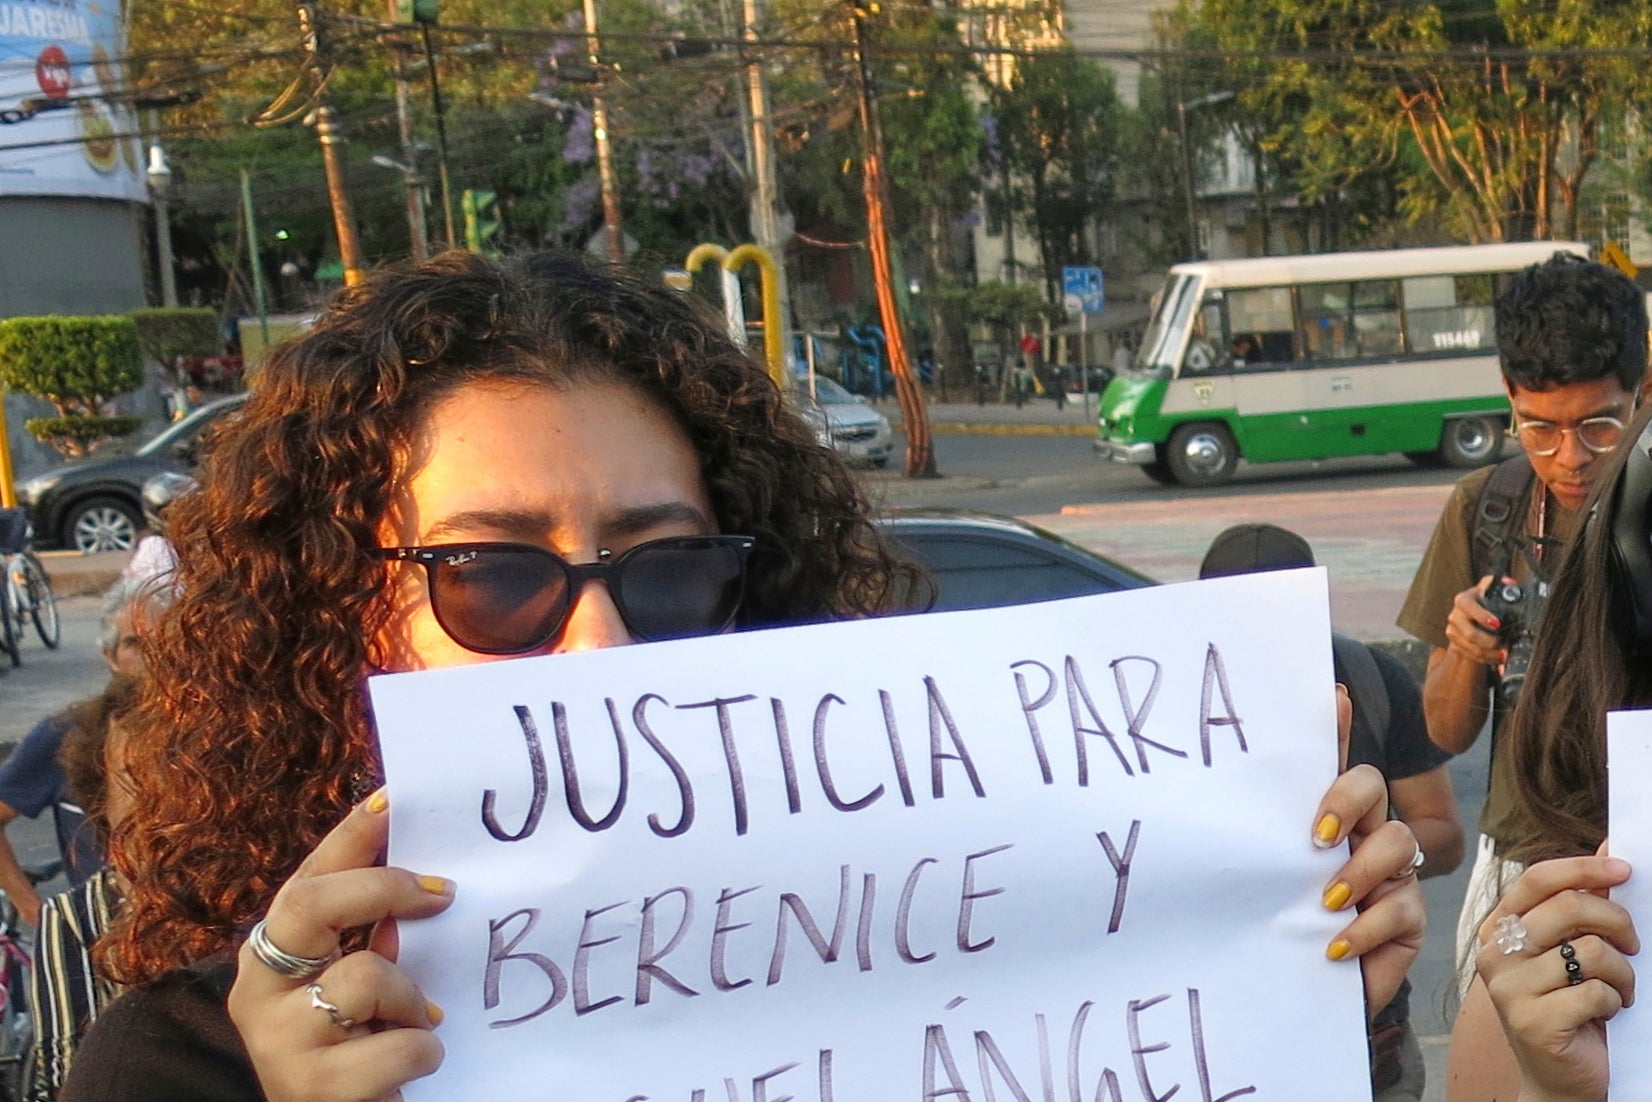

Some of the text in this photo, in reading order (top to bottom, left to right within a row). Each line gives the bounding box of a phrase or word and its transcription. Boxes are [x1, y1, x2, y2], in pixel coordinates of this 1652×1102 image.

[482, 641, 1249, 842] JUSTICIA PARA
[482, 819, 1142, 1030] BERENICE Y
